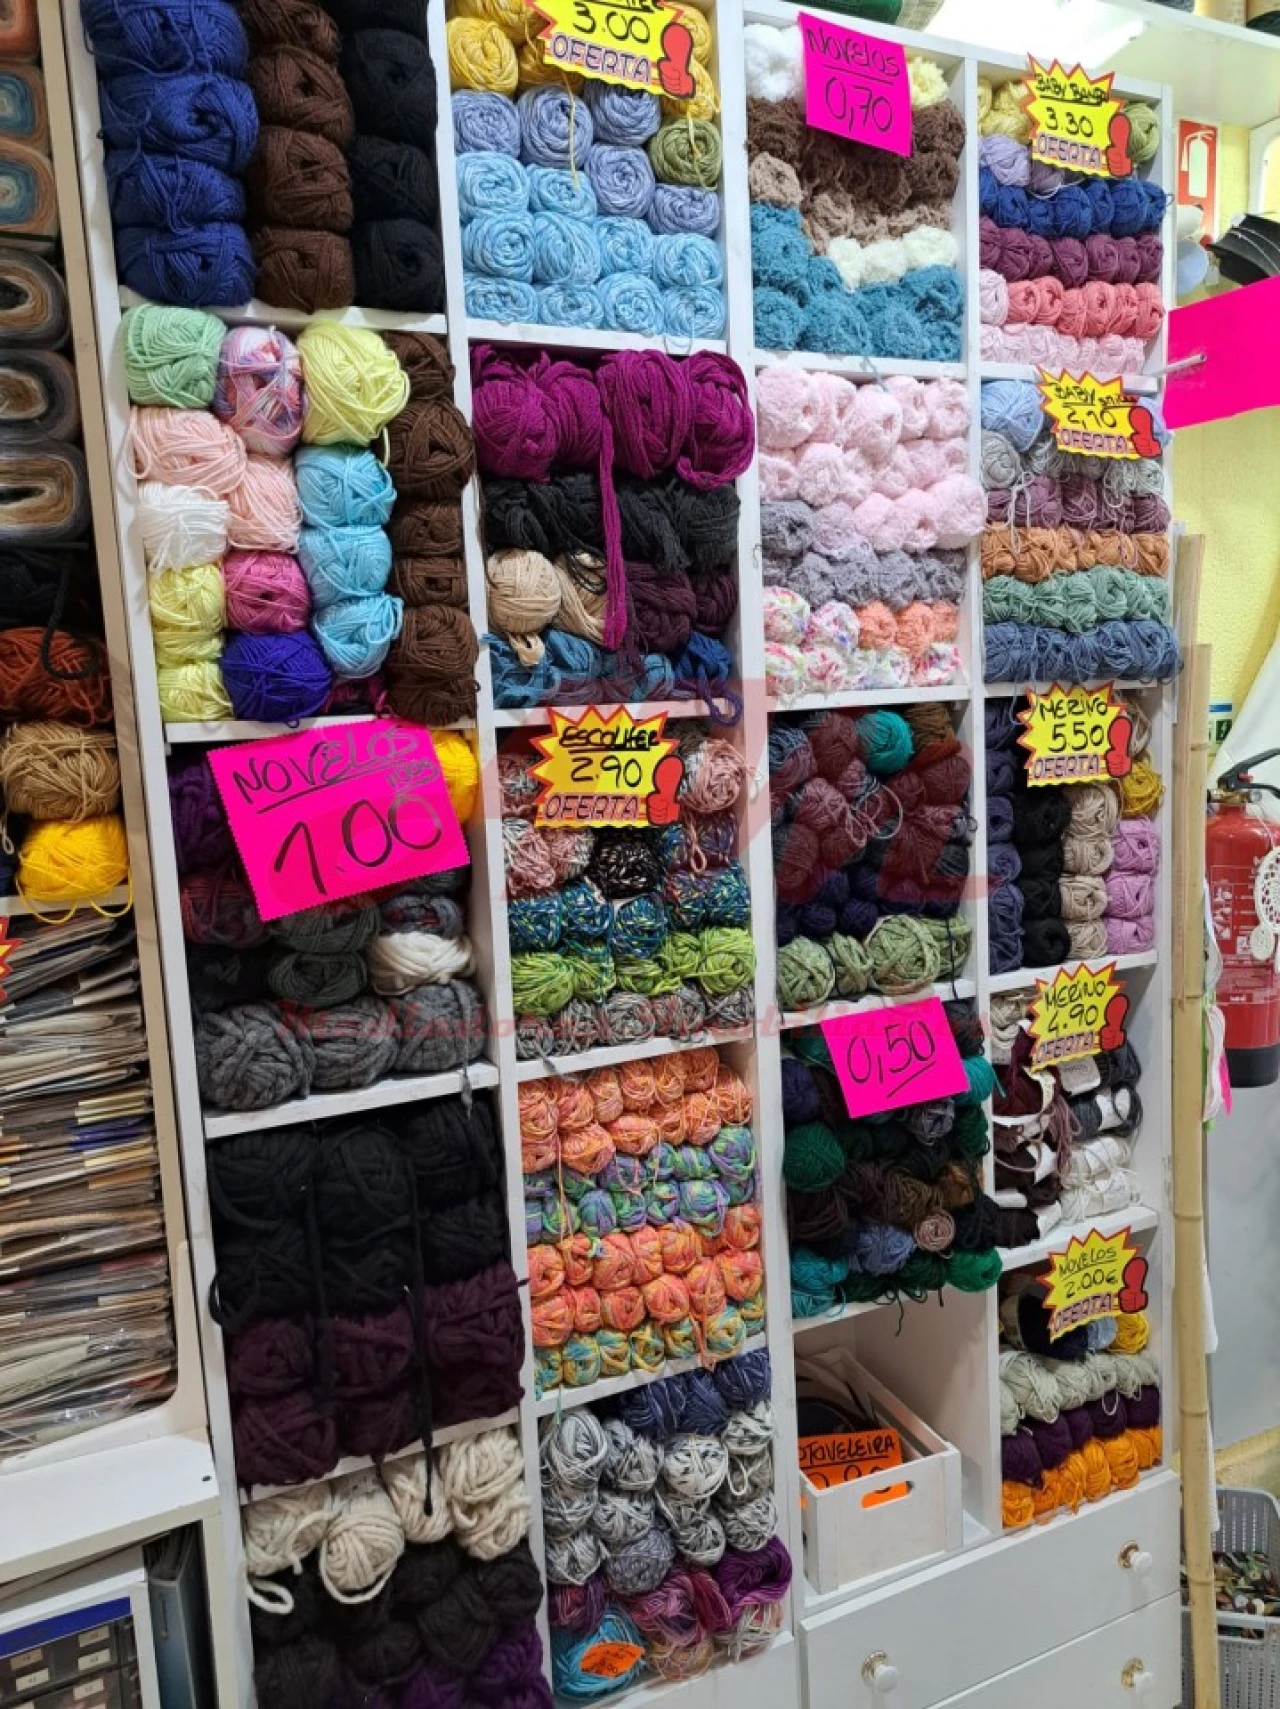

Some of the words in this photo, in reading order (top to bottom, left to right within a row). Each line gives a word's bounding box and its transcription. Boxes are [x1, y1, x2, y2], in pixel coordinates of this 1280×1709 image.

[552, 34, 651, 83] OFERTA
[825, 76, 893, 133] 0,70
[1045, 106, 1094, 138] 3.30
[1037, 133, 1100, 169] OFERTA
[1061, 428, 1127, 454] OFERTA
[1039, 697, 1108, 721] MERINO
[558, 726, 661, 748] ESCOLHER
[232, 725, 419, 805] NOVELOS
[571, 755, 642, 788] 2.90
[1033, 754, 1099, 779] OFERTA
[543, 794, 639, 820] OFERTA
[273, 794, 442, 896] 1.00
[1048, 1003, 1098, 1034] 4.90
[847, 1020, 936, 1084] 0,50
[1035, 1030, 1095, 1065] OFERTA
[1053, 1292, 1113, 1333] OFERTA
